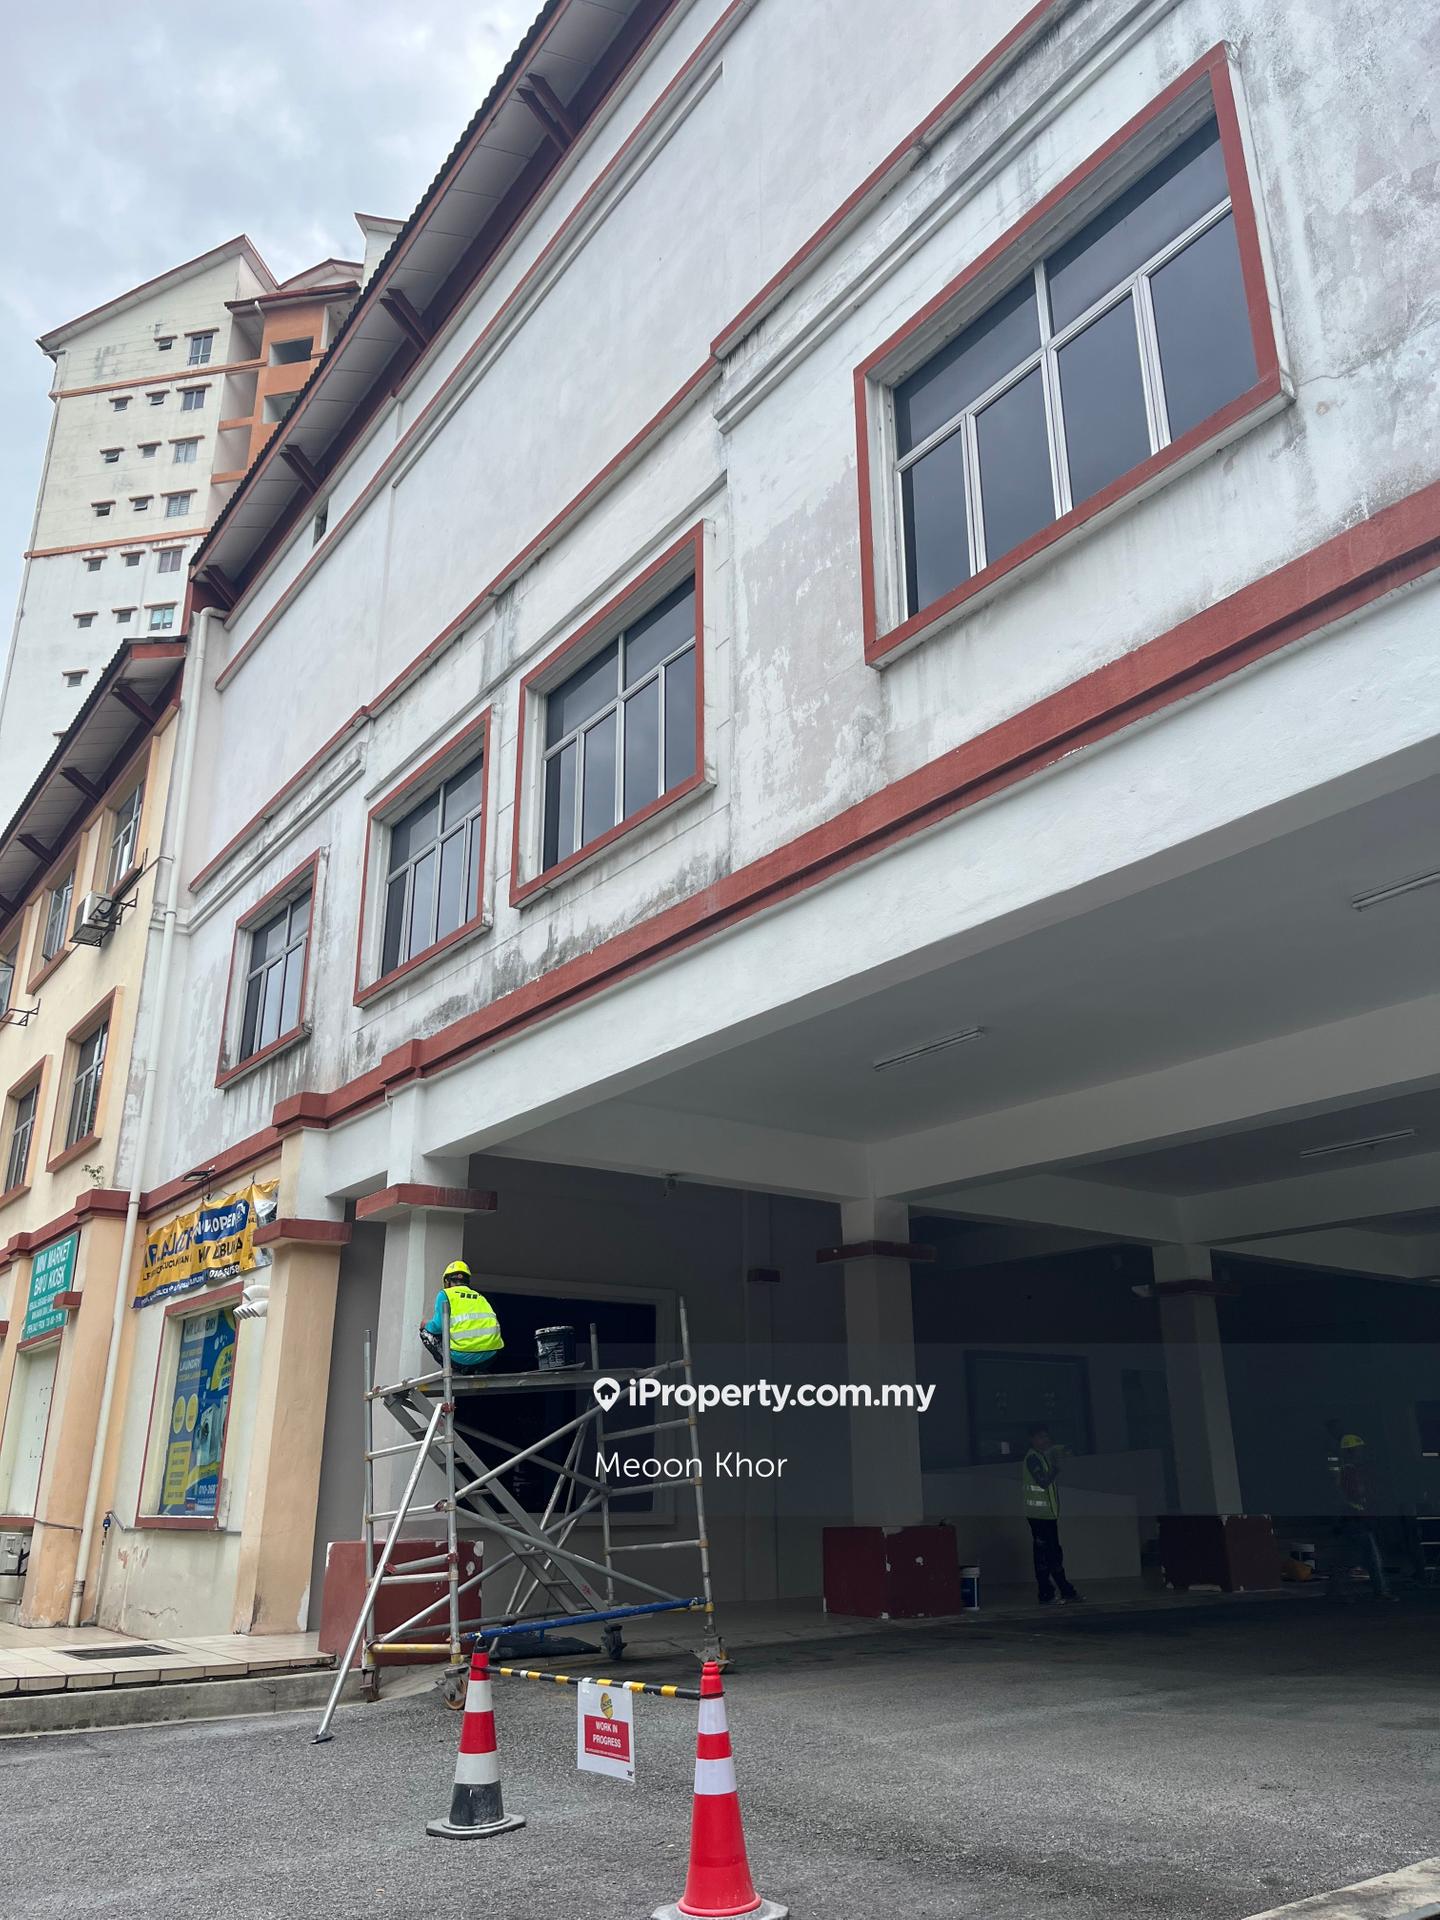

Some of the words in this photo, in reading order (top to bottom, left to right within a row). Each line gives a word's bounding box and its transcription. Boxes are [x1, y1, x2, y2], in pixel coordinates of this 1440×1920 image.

[47, 1240, 71, 1269] MARKET
[47, 1264, 66, 1290] KIOSK
[595, 1721, 611, 1732] WORK
[612, 1724, 618, 1733] IN
[592, 1734, 622, 1748] PROGRESS
